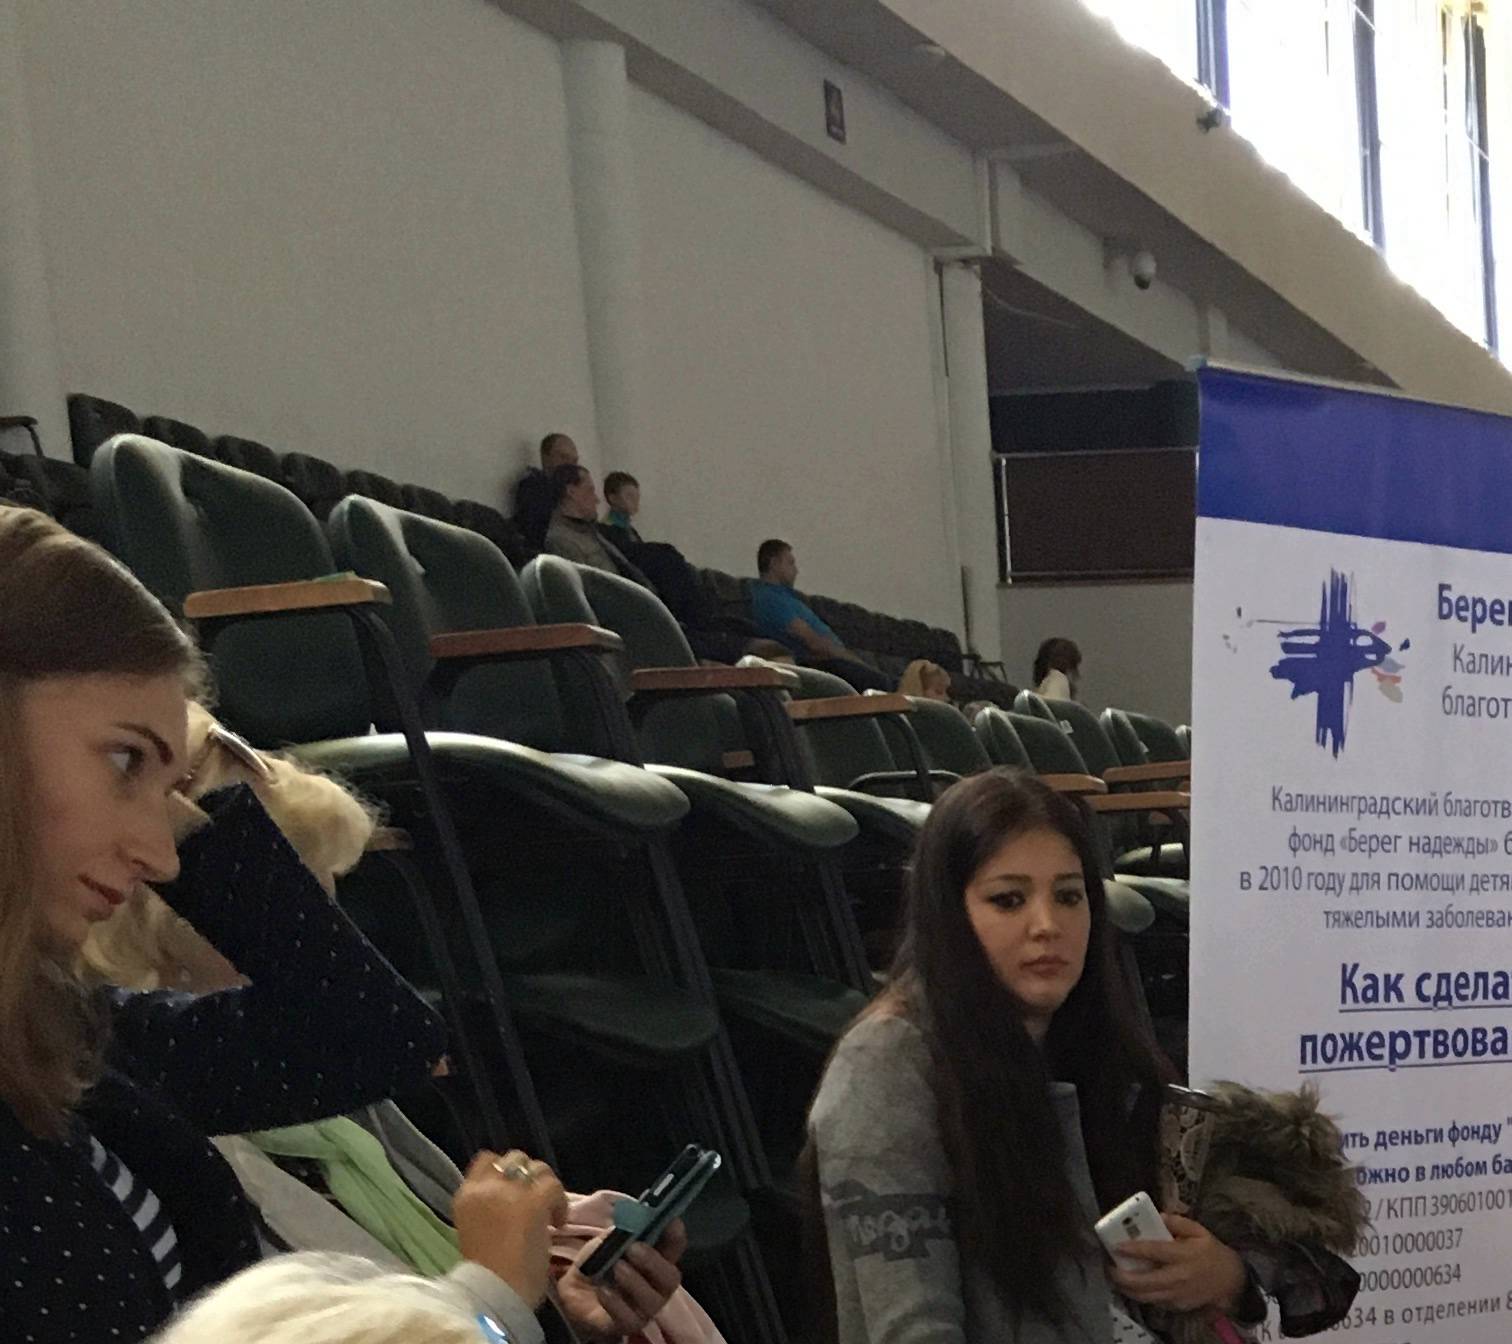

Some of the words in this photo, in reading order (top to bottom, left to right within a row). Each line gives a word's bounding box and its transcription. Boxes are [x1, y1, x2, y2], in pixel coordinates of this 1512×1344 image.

[1272, 786, 1439, 820] Калининградский
[1288, 829, 1335, 858] фонд
[1340, 828, 1402, 857] «Берег
[1408, 833, 1499, 857] надежды»
[1239, 871, 1251, 890] в
[1259, 866, 1303, 891] 2010
[1307, 872, 1345, 897] году
[1350, 871, 1381, 894] для
[1387, 872, 1465, 894] помощи
[1323, 908, 1420, 930] тяжелыми
[1340, 963, 1405, 1005] Как
[1340, 1131, 1369, 1149] ить
[1374, 1127, 1443, 1151] деньги
[1448, 1120, 1501, 1147] фонду
[1356, 1165, 1410, 1186] ожно
[1415, 1165, 1426, 1182] в
[1430, 1158, 1487, 1180] любом
[1387, 1196, 1427, 1219] КПП
[1355, 1228, 1463, 1258] 0010000037
[1360, 1264, 1461, 1292] 0000000634
[1384, 1309, 1395, 1325] в
[1401, 1296, 1501, 1326] отделении
